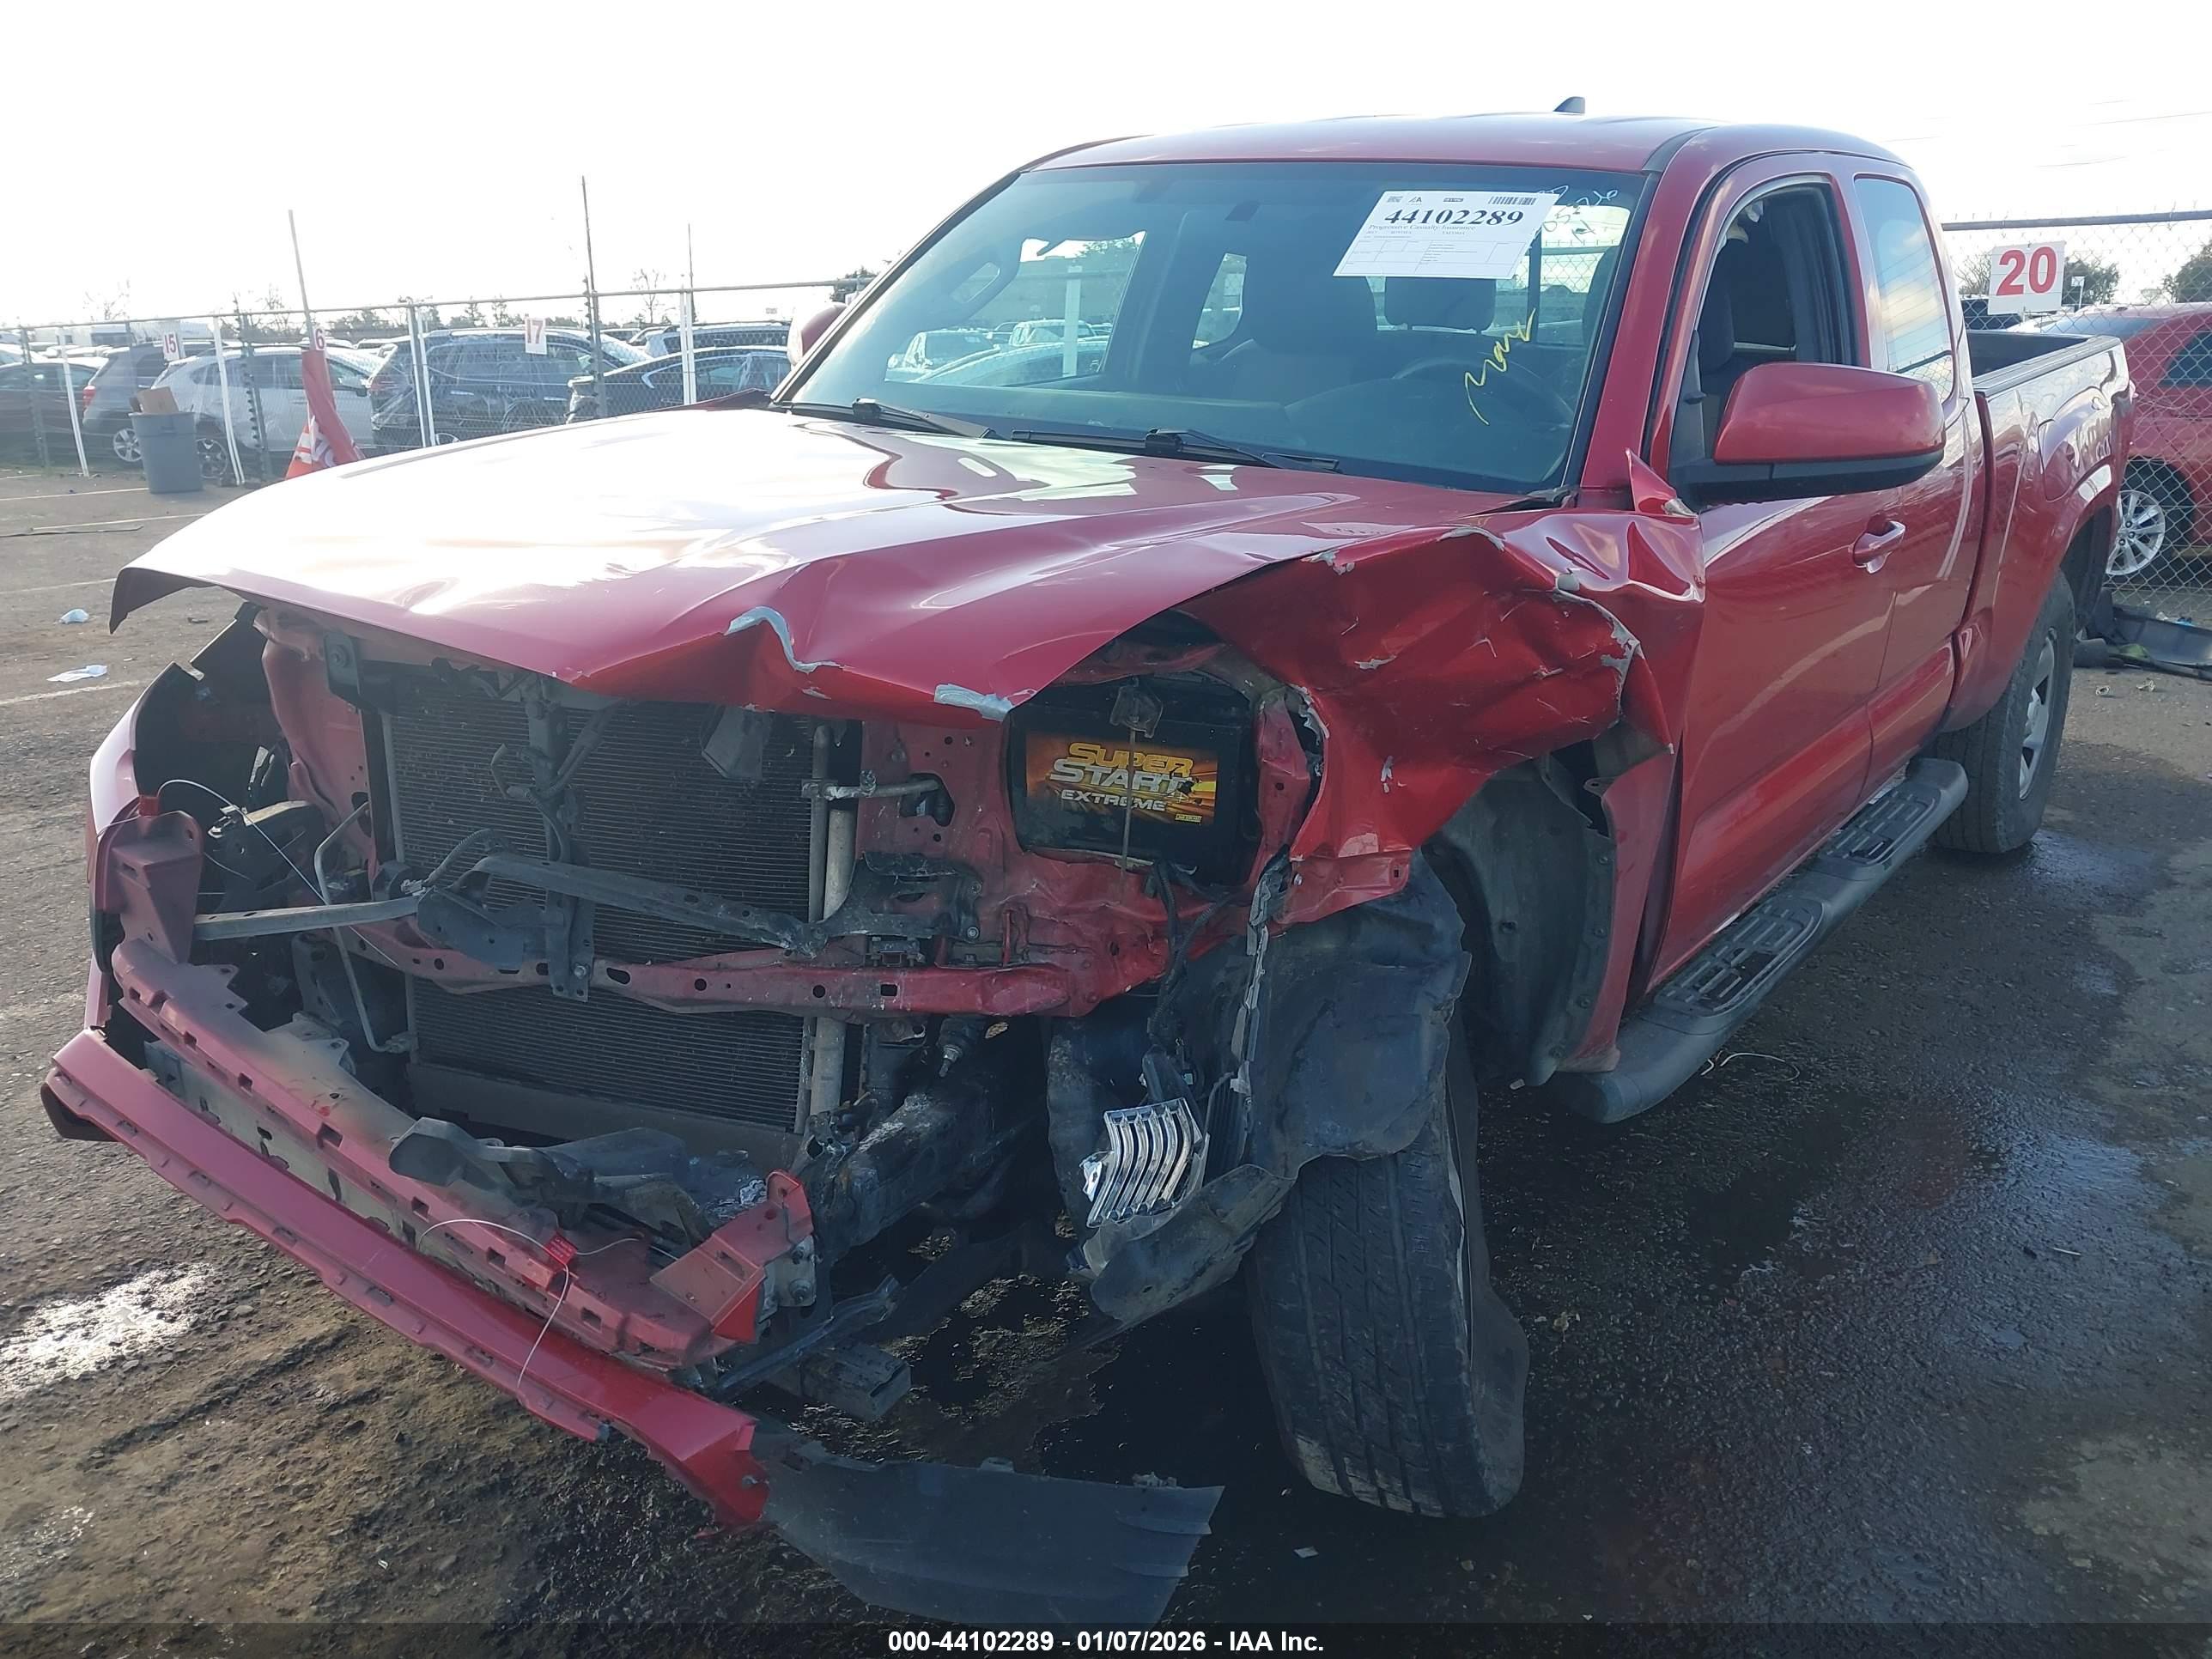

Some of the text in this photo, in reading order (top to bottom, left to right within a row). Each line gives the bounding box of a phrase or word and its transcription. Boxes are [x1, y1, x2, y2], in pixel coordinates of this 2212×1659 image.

[1384, 209, 1524, 226] 44102289
[1996, 246, 2057, 296] 20
[315, 328, 325, 349] 6
[526, 319, 544, 344] 17
[164, 333, 177, 354] 15
[1067, 742, 1194, 778] SUPER
[1050, 758, 1193, 794] START
[1061, 789, 1168, 811] EXTREME
